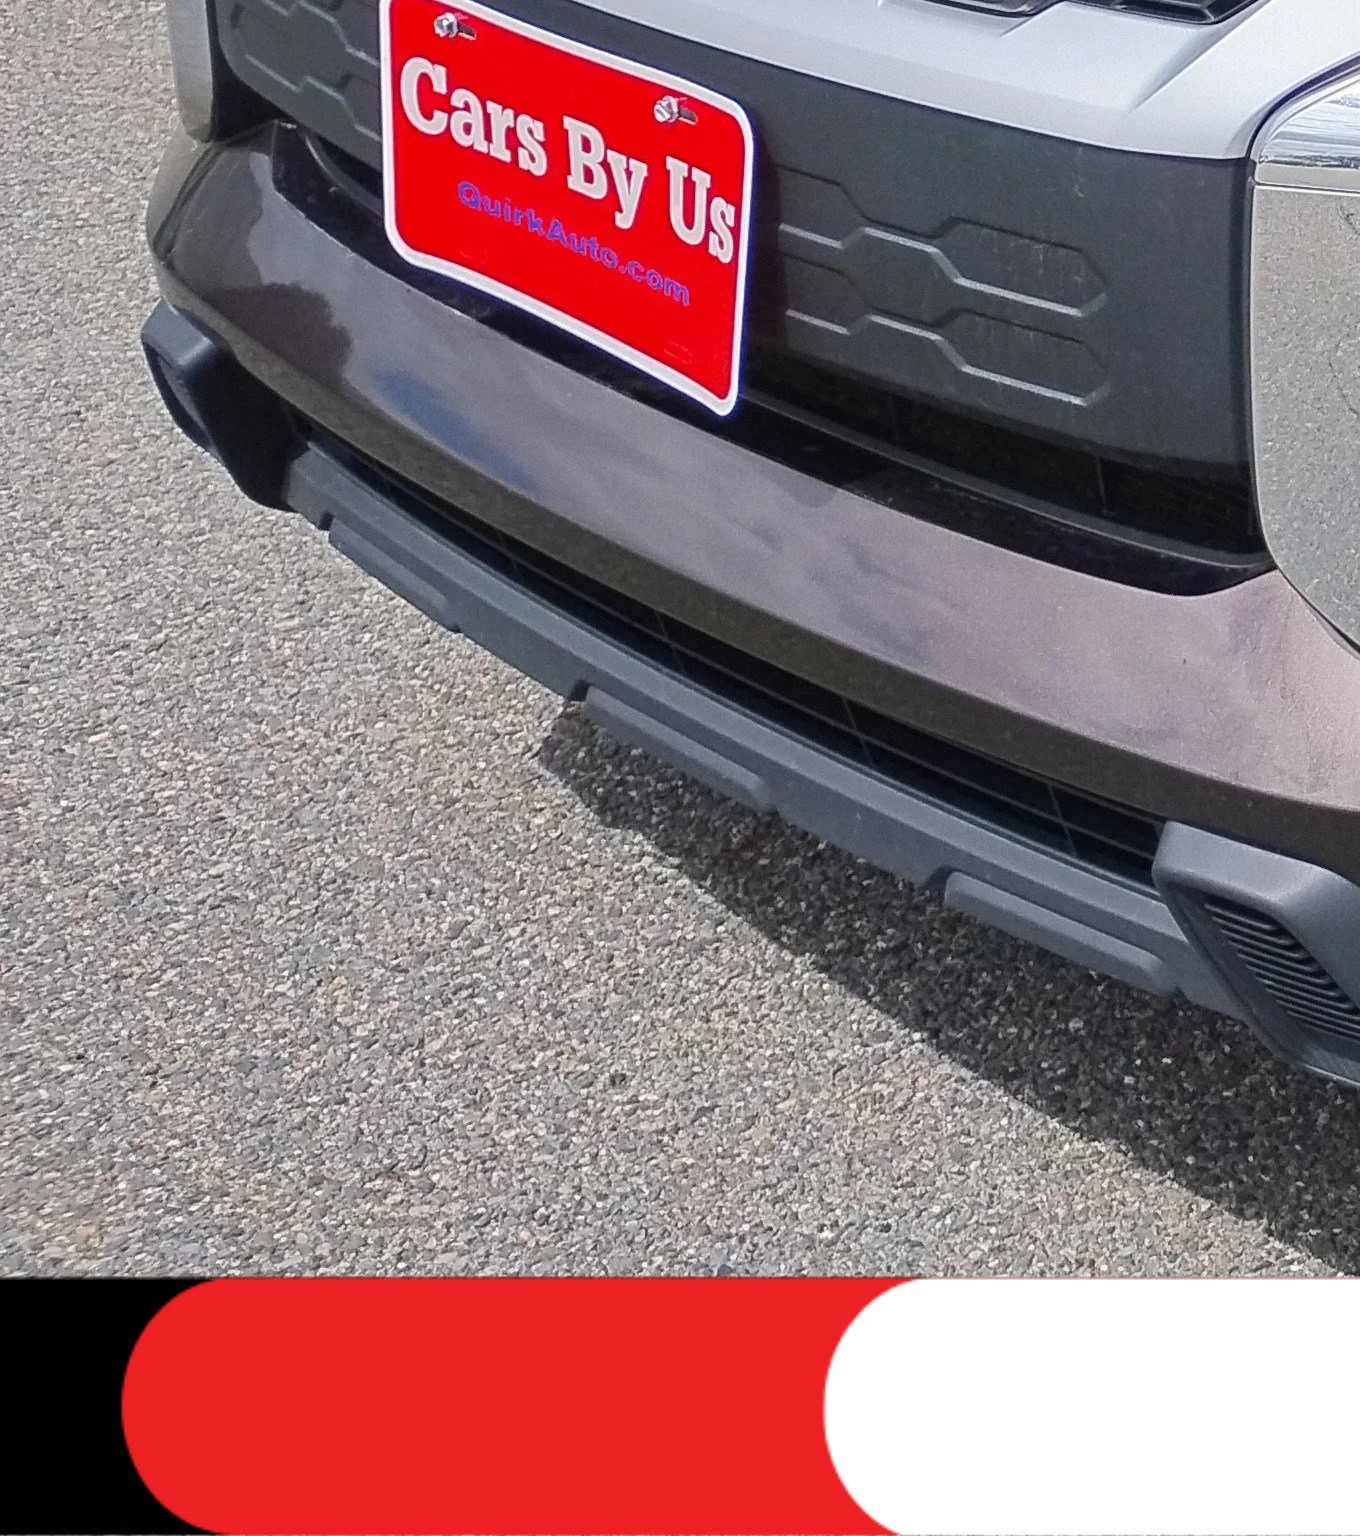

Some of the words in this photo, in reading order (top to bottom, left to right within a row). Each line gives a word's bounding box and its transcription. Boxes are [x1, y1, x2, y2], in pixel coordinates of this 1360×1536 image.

[400, 56, 548, 177] Cars
[562, 115, 649, 230] By
[665, 155, 736, 264] Us
[456, 180, 690, 306] QuirkAuto.com
